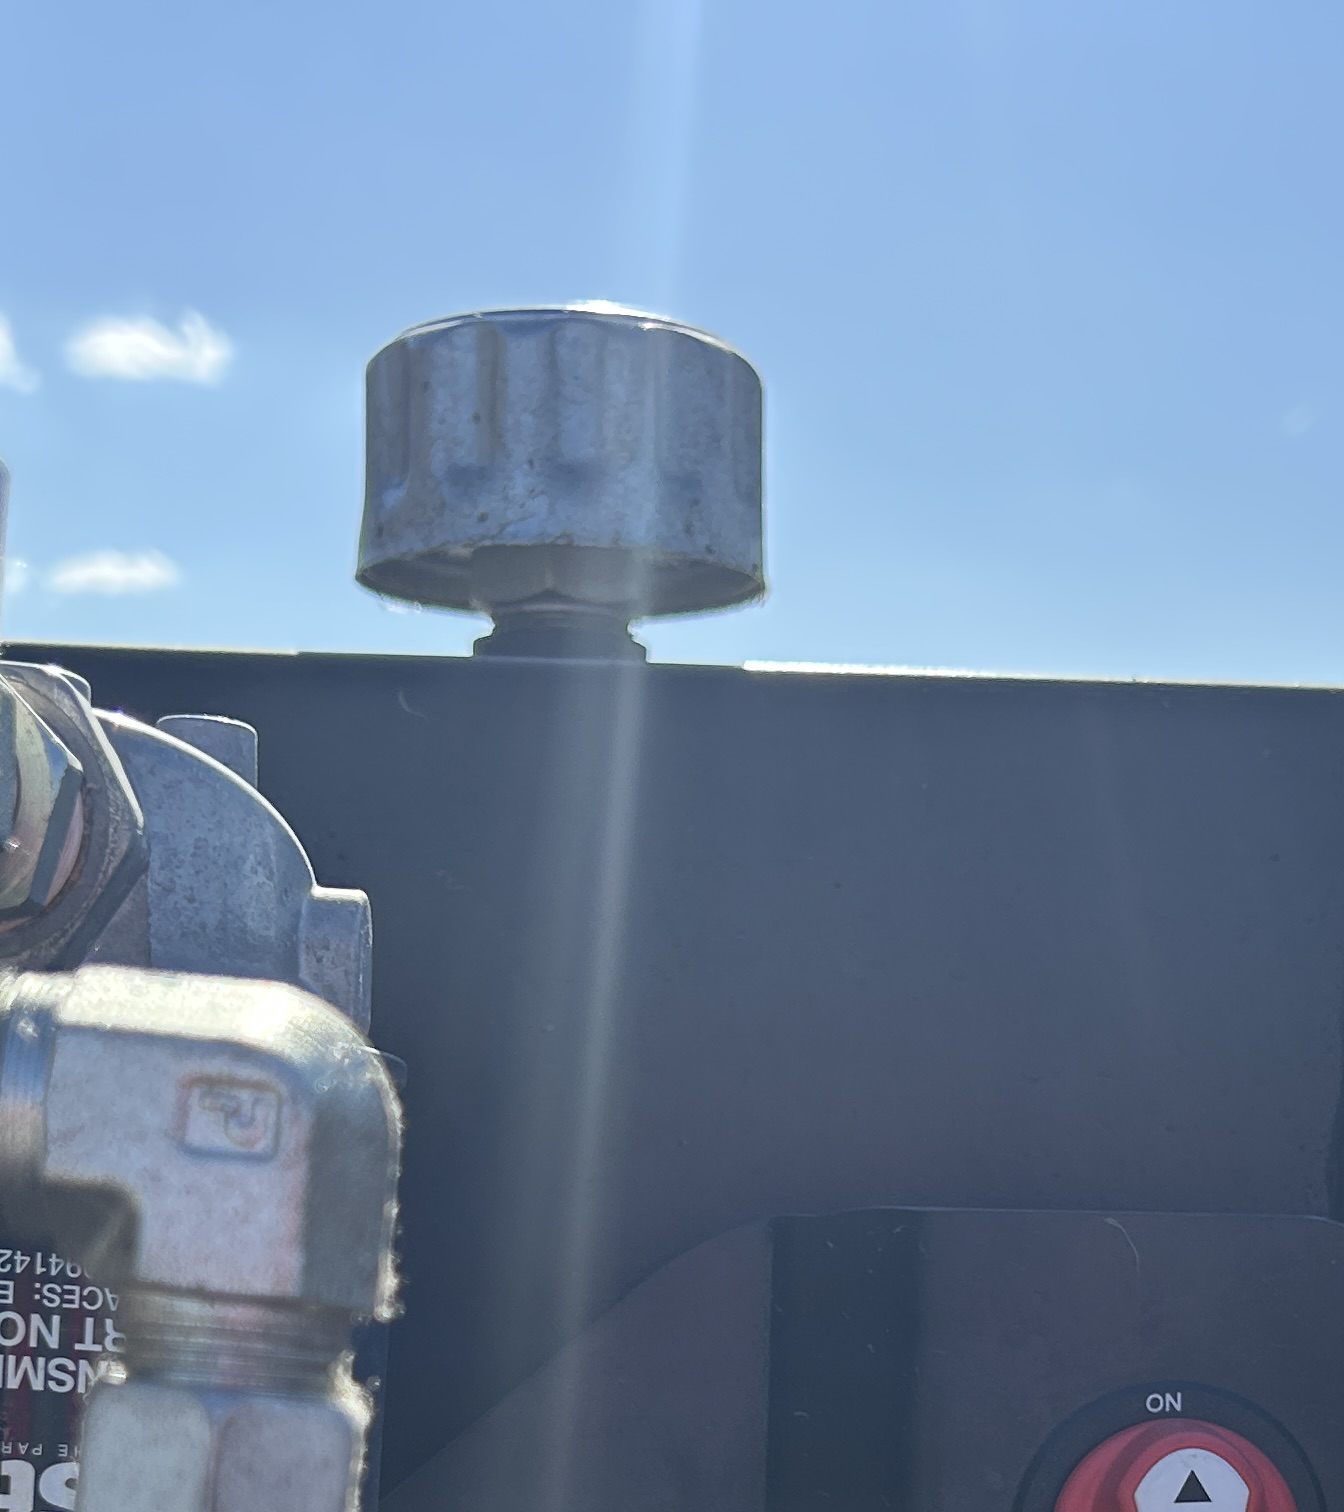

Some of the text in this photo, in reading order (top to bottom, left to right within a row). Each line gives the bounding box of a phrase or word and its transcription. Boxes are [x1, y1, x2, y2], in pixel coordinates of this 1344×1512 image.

[34, 1282, 120, 1312] ACES:
[74, 1317, 127, 1352] RT
[1145, 1392, 1182, 1413] ON
